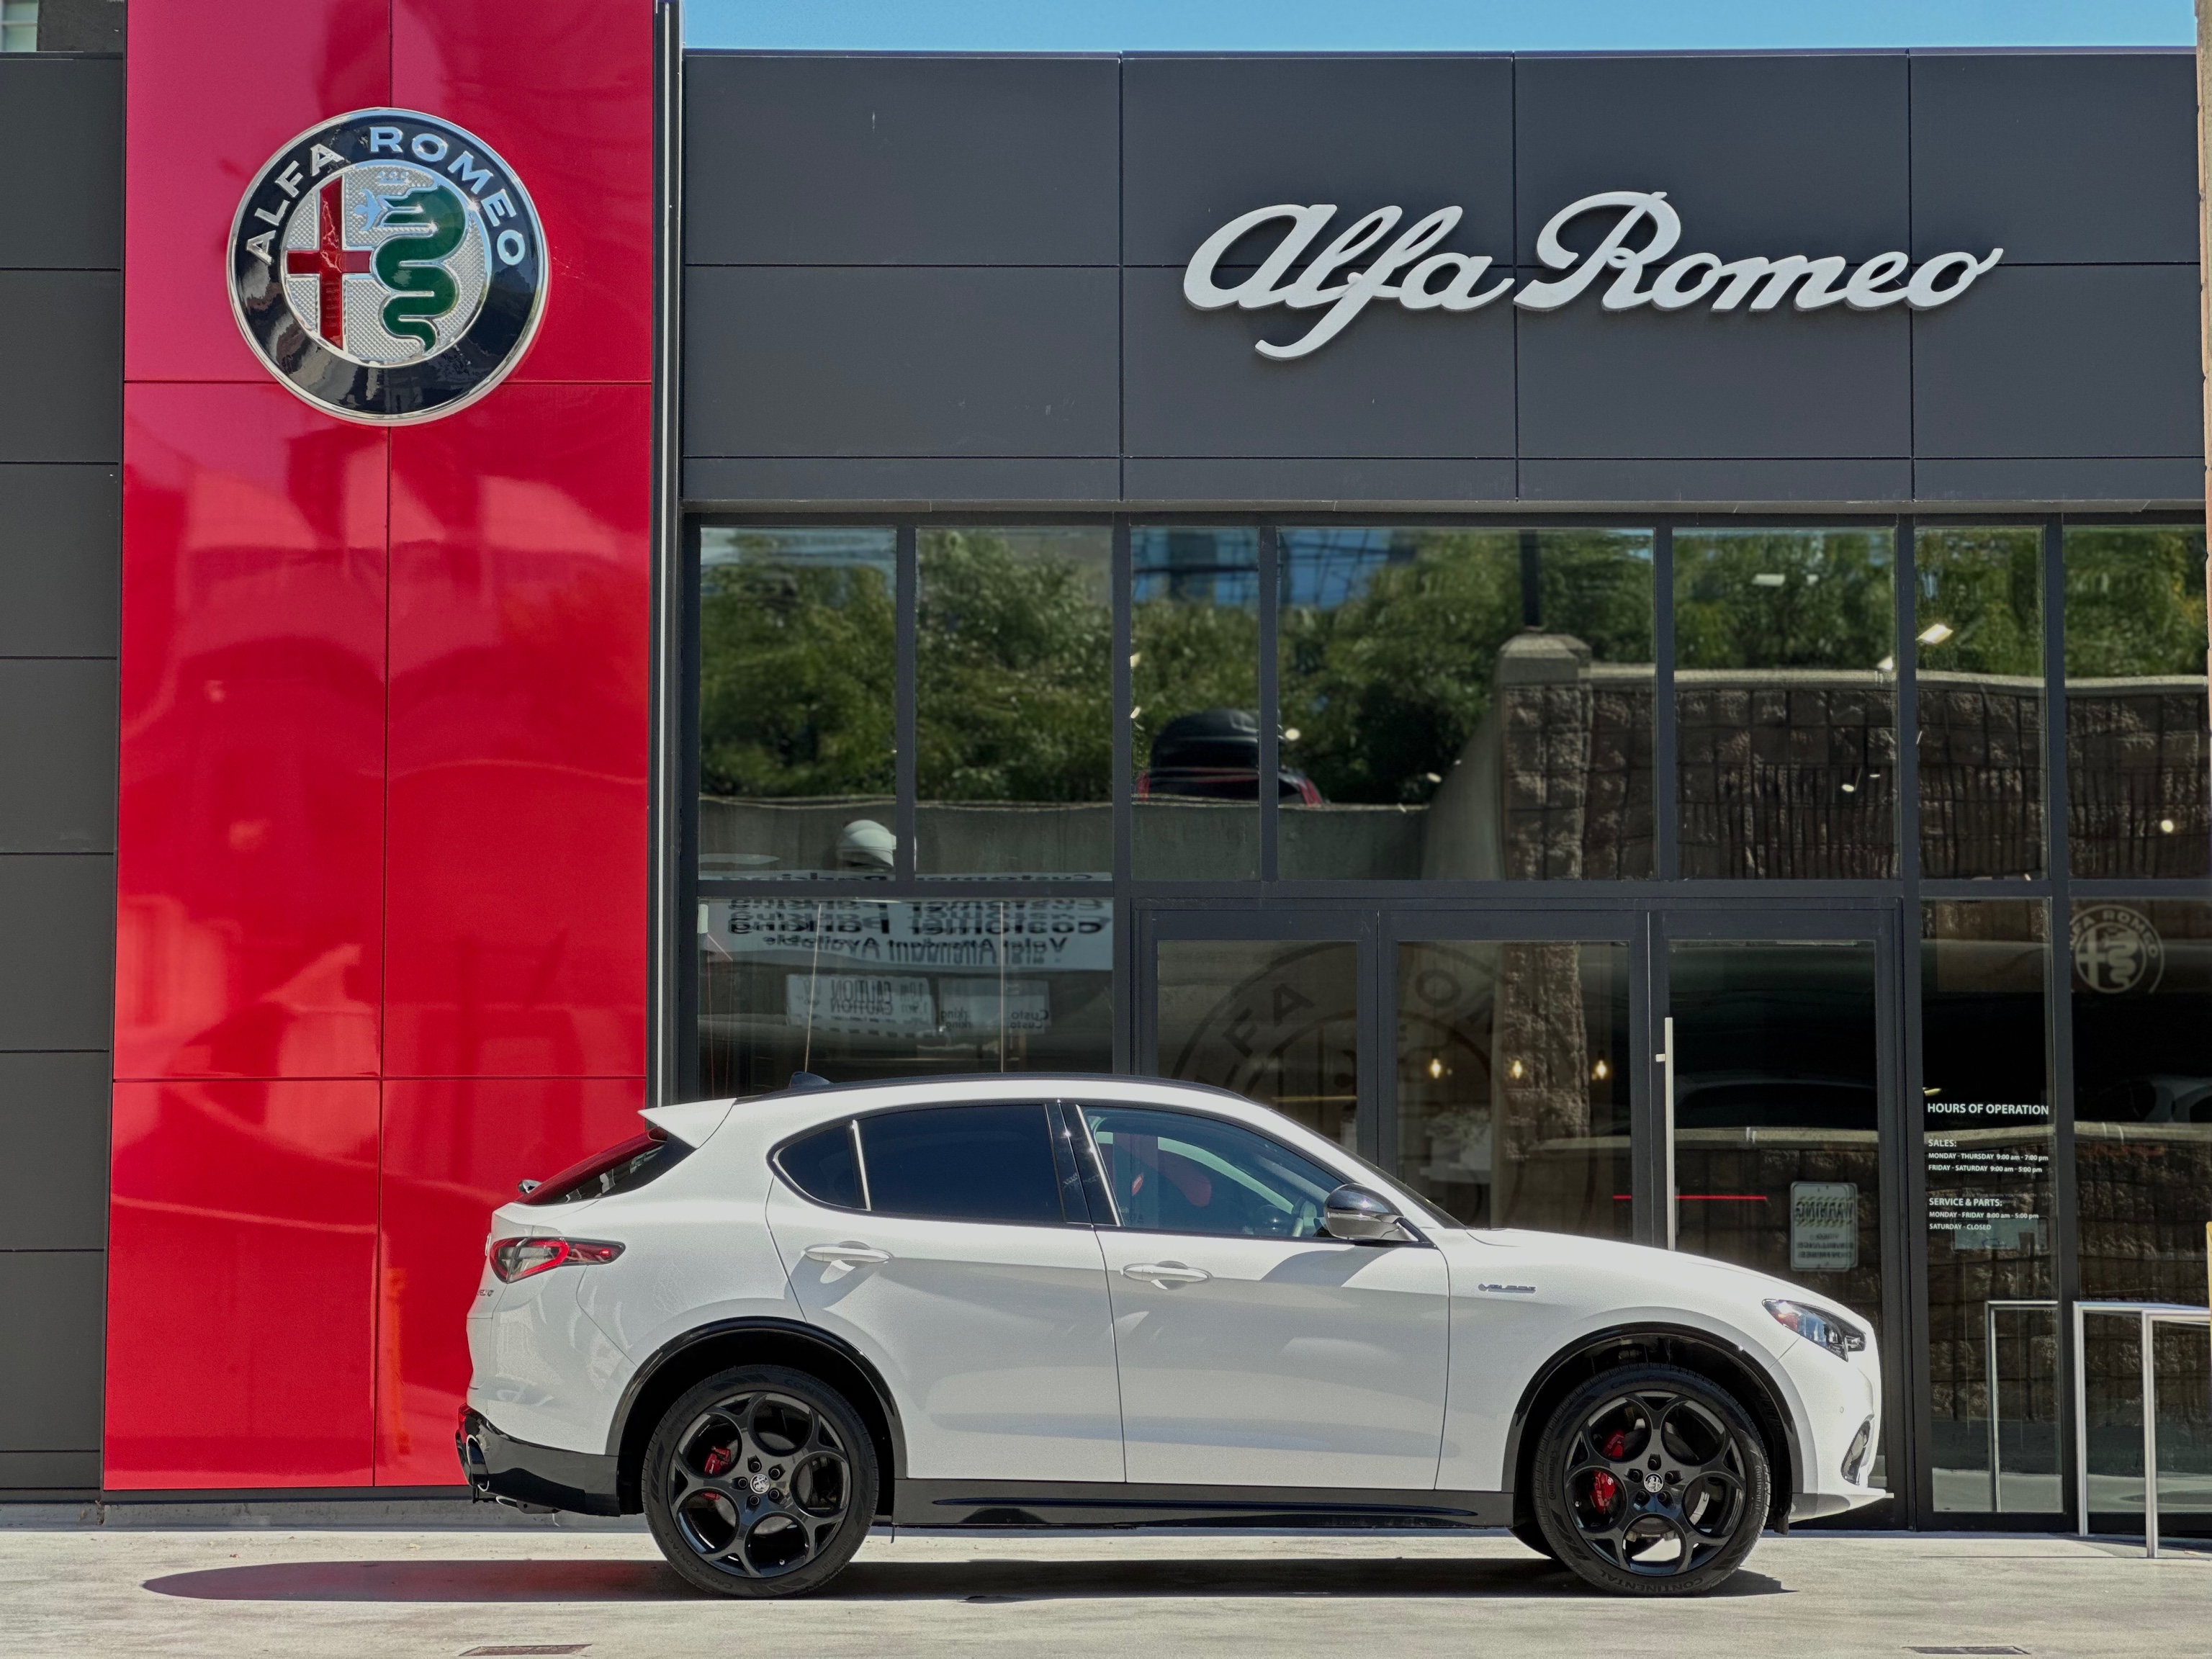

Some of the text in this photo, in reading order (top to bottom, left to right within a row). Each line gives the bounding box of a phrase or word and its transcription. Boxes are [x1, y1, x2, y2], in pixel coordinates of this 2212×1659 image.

[246, 127, 526, 266] ALFA ROMEO
[1183, 192, 2004, 359] Alfa Romeo
[1928, 1103, 2049, 1115] HOURS OF OPERATION
[1929, 1197, 1964, 1206] SERVICE
[1974, 1198, 2002, 1207] PARTS:
